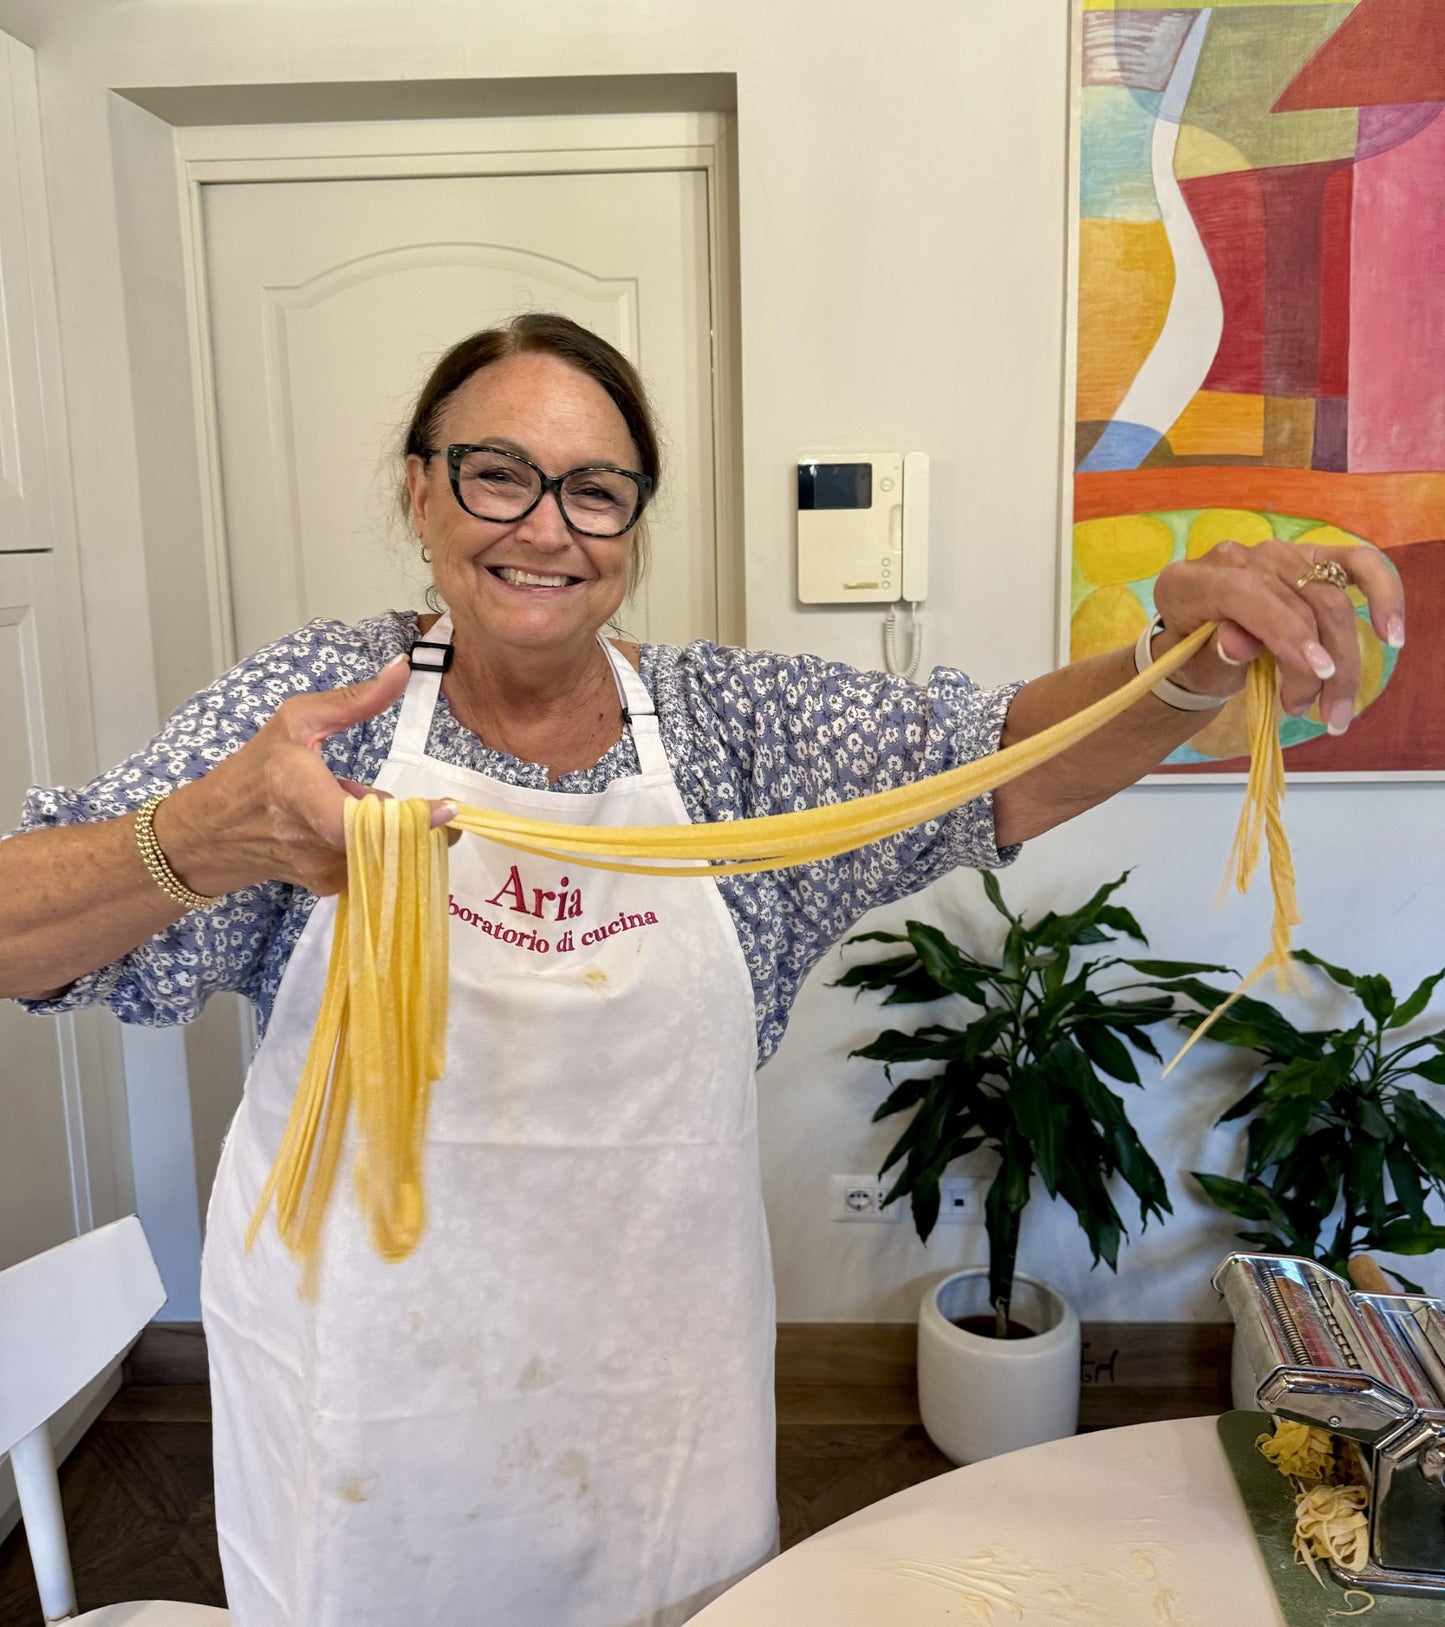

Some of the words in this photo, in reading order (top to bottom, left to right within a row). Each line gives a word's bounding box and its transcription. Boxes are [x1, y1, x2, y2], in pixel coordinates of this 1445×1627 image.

[485, 865, 583, 921] Aria
[448, 894, 550, 953] boratorio
[556, 931, 575, 953] di
[581, 911, 659, 947] cucina
